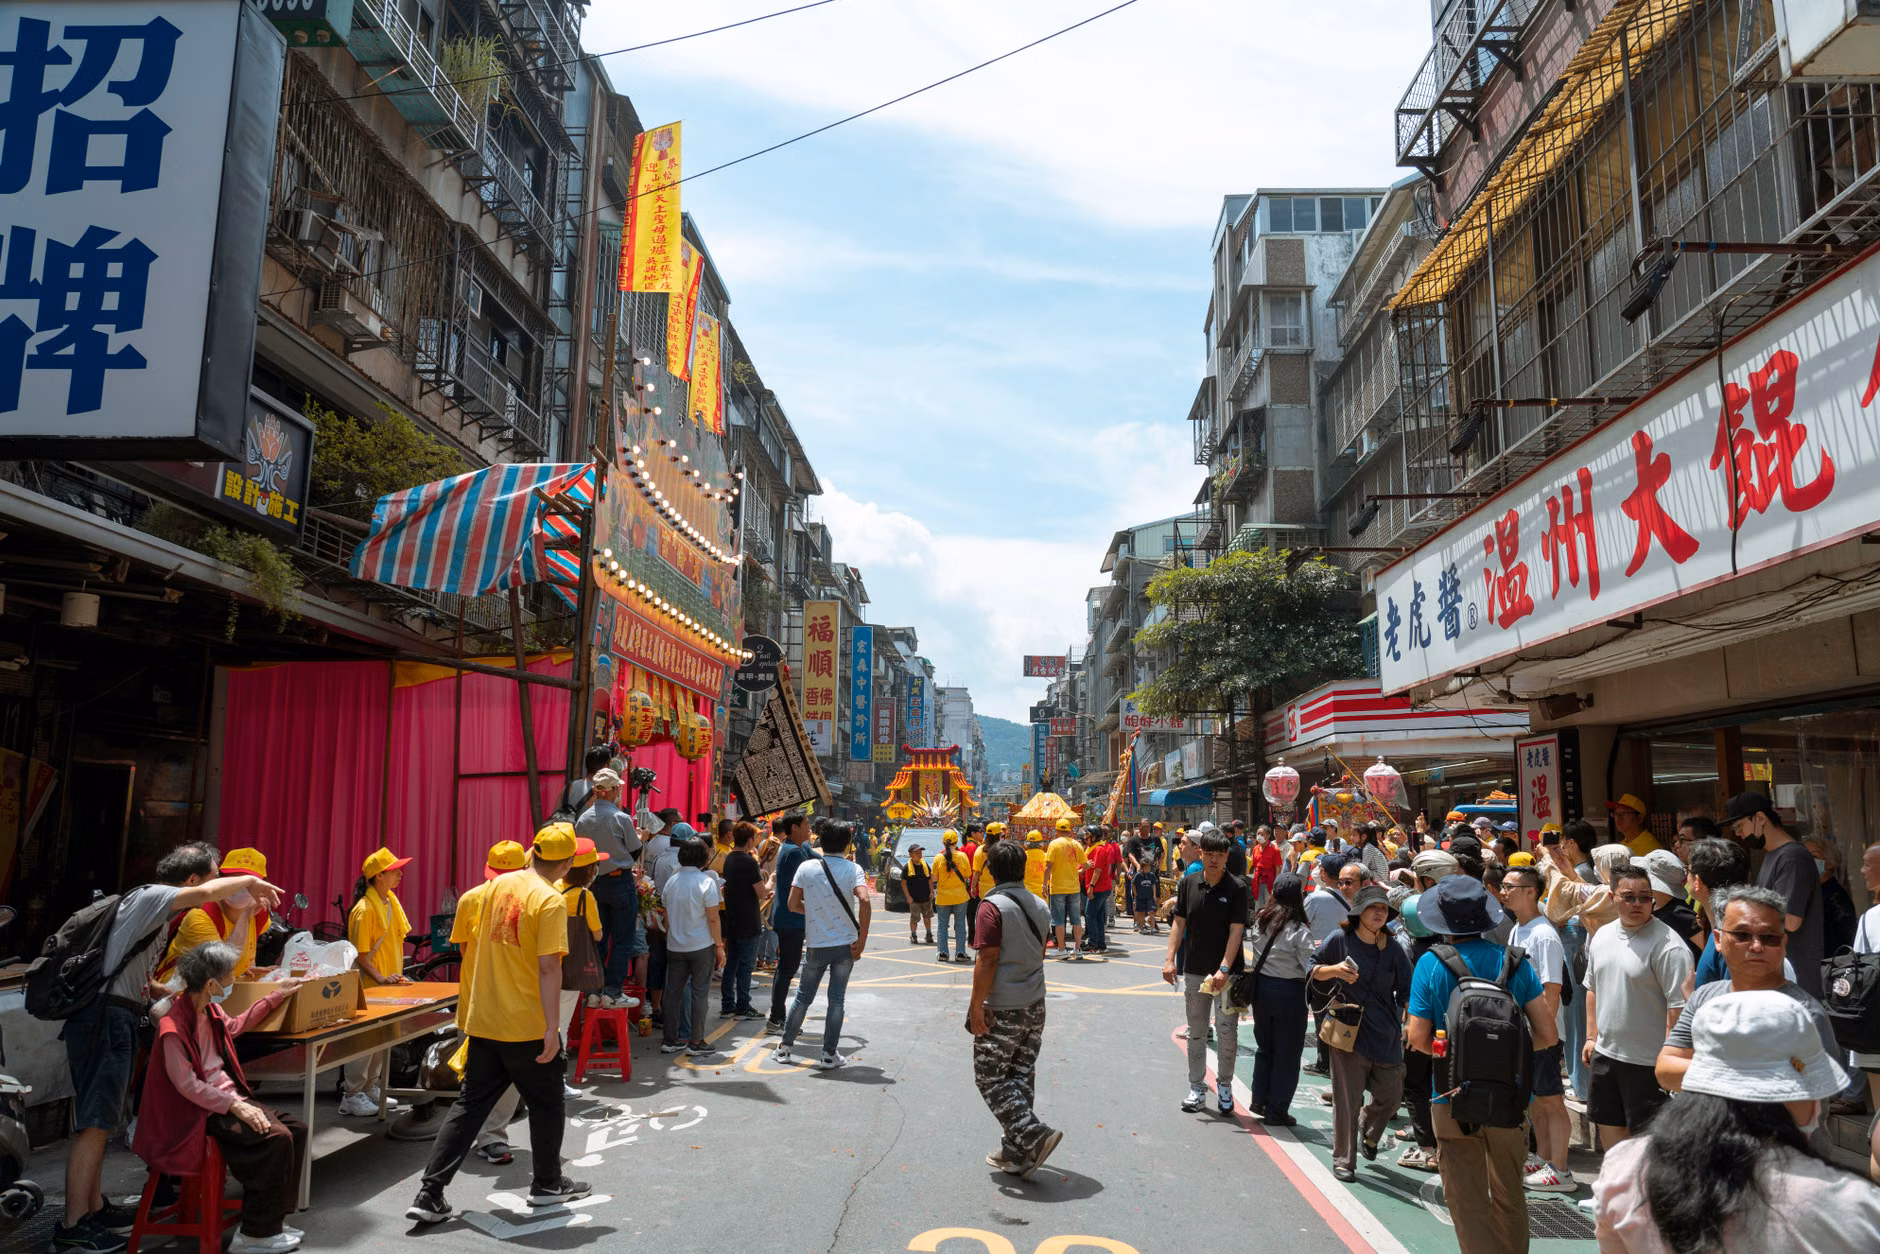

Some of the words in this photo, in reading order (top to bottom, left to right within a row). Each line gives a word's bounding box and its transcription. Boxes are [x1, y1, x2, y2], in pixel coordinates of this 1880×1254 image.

[0, 15, 184, 416] 招牌
[224, 469, 300, 525] 設計施工
[1483, 330, 1880, 631] 溫州大餛
[808, 615, 834, 679] 福順
[1124, 715, 1185, 729] 姐妹小館
